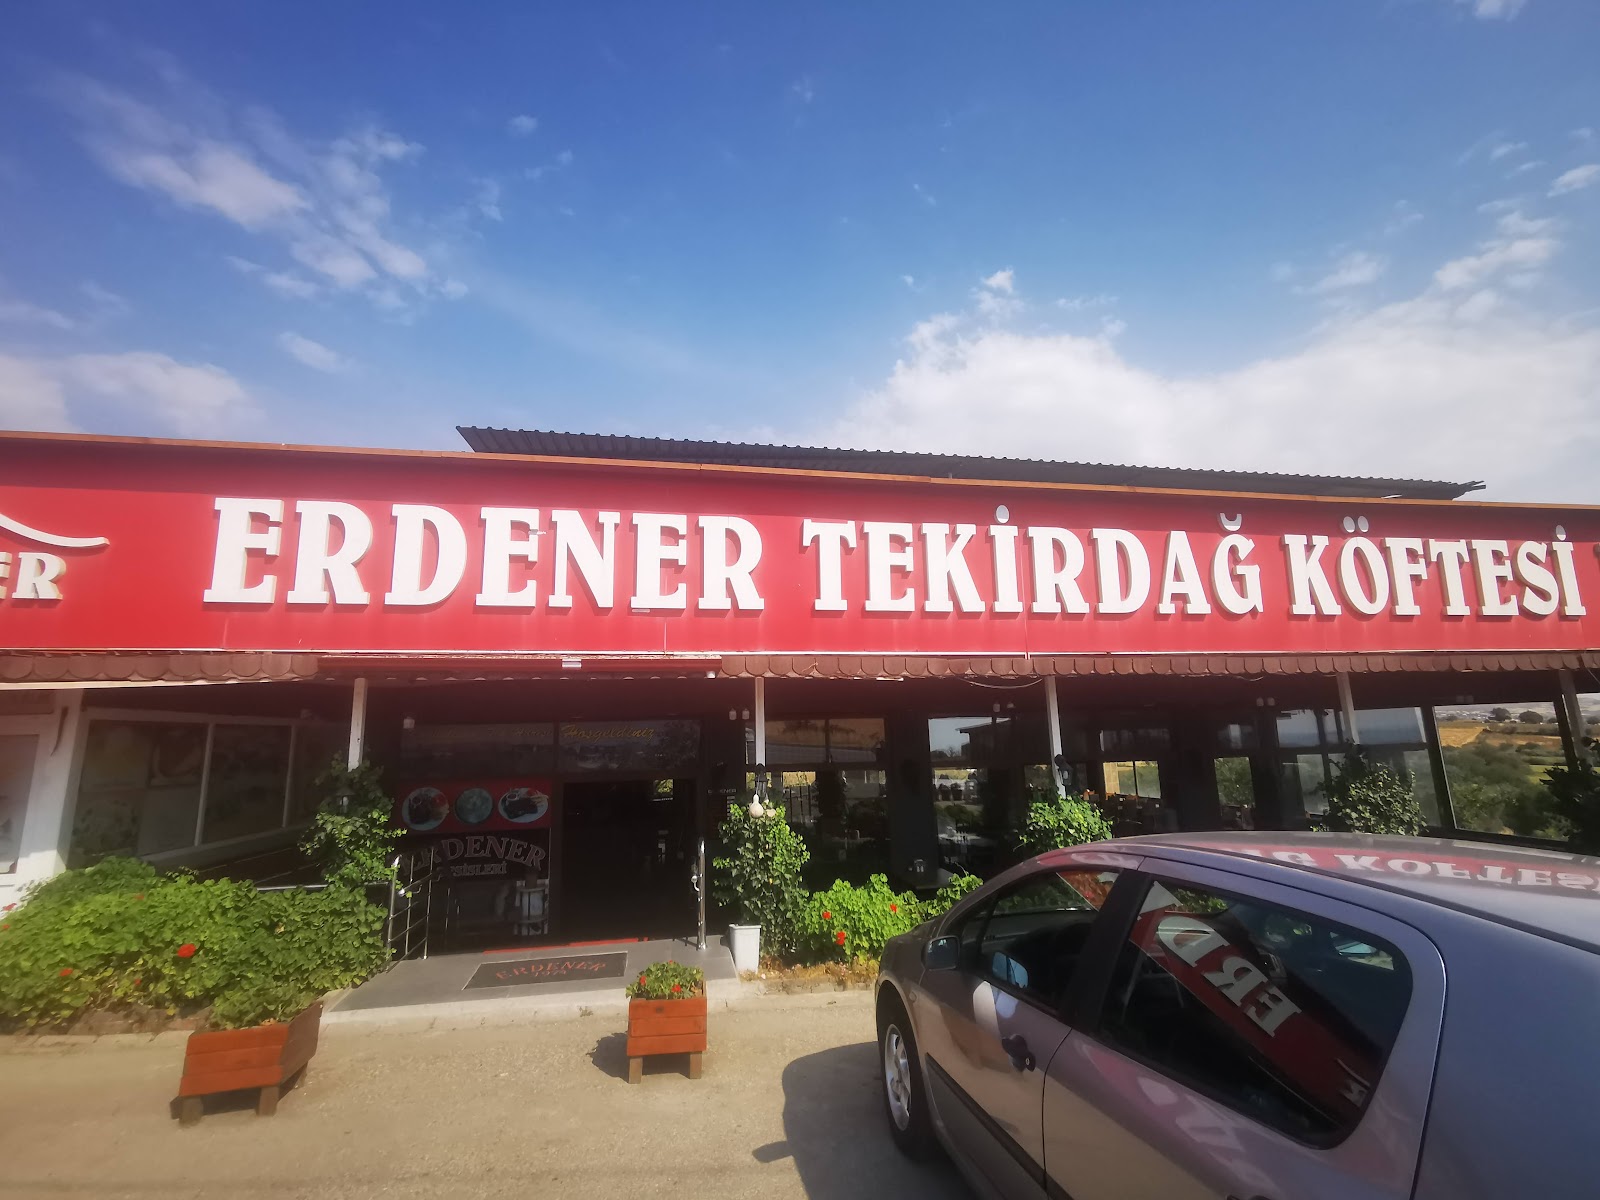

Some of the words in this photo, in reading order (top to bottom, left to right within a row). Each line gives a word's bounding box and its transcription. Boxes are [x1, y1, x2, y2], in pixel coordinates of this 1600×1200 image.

[203, 497, 766, 611] ERDENER
[802, 504, 1264, 615] TEKİRDAĞ
[1283, 516, 1587, 616] KÖFTESİ
